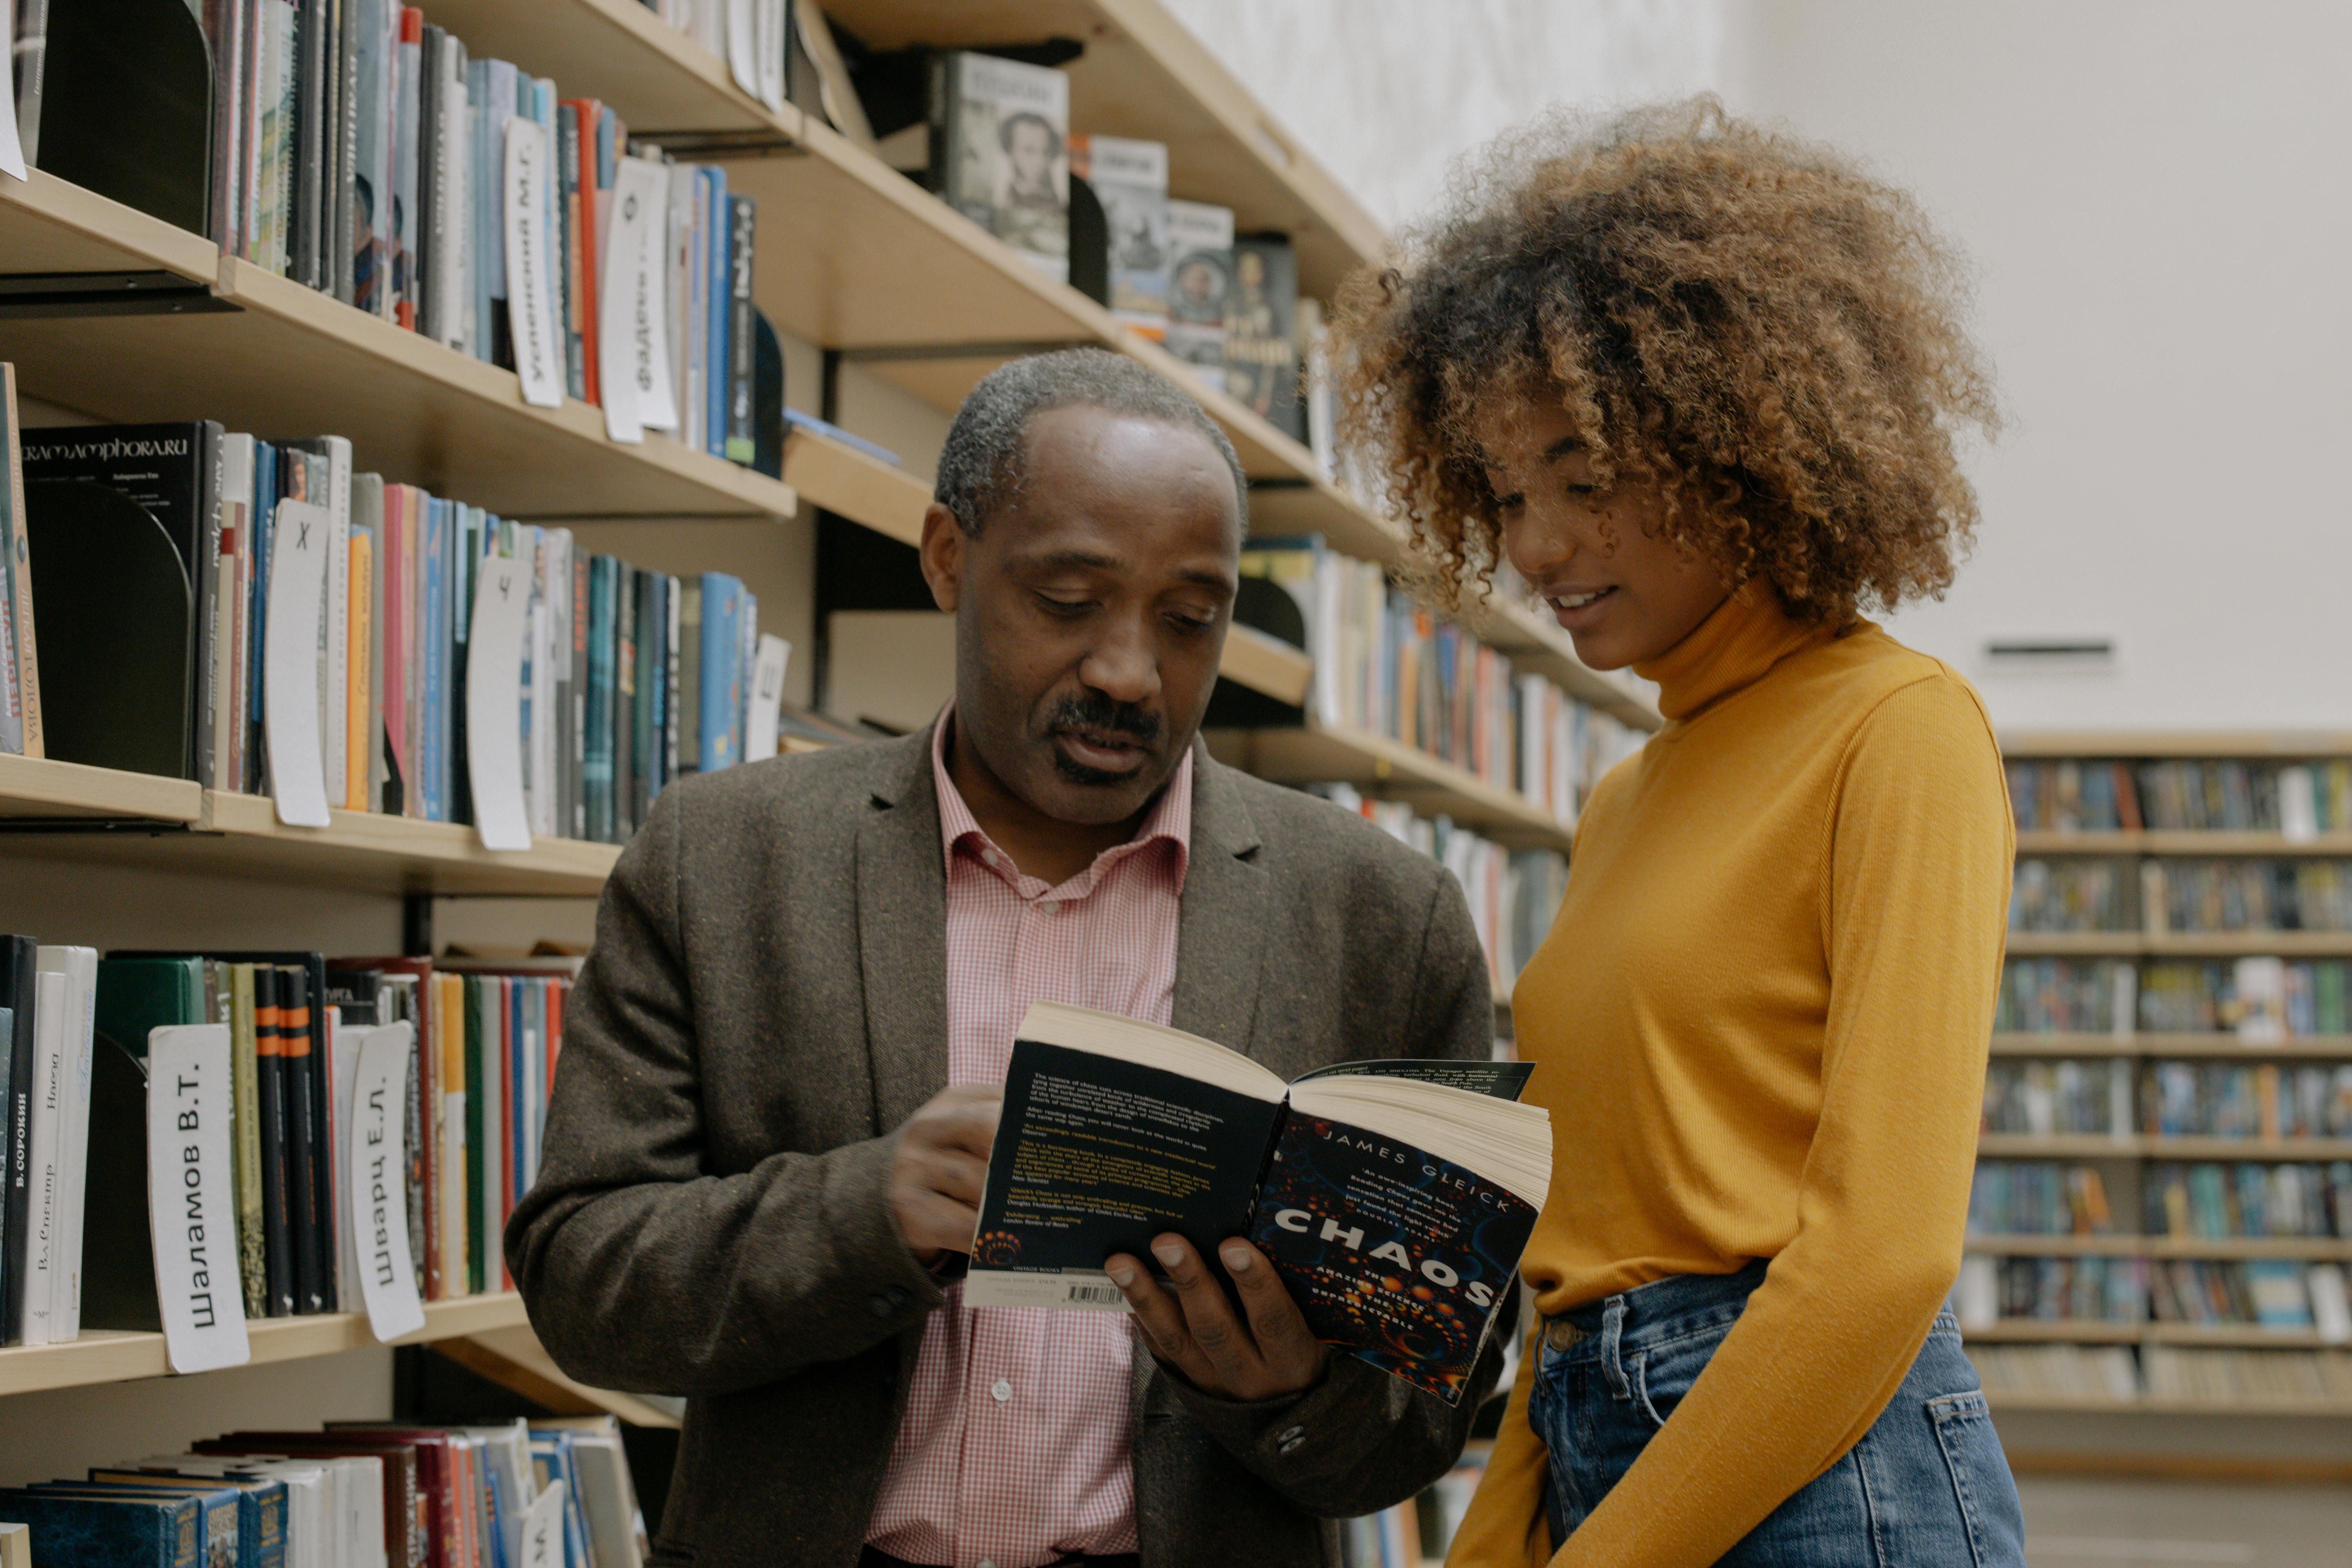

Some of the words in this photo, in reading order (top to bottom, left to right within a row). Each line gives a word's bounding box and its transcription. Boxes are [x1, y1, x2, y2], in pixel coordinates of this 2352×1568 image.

[178, 1063, 199, 1130] В.Т.
[368, 1076, 387, 1146] Е.Л.
[1048, 1076, 1070, 1085] science
[1080, 1082, 1097, 1090] chaos
[1134, 1094, 1165, 1106] traditional
[16, 1092, 27, 1172] СОРОКИН
[1045, 1110, 1067, 1119] reading
[1131, 1126, 1145, 1134] look
[1165, 1135, 1183, 1144] world
[1191, 1143, 1207, 1152] quite
[1323, 1130, 1406, 1164] JAMES
[1422, 1165, 1510, 1213] GLEICK
[1378, 1174, 1433, 1200] awe-inspiring
[372, 1155, 394, 1286] Шварц
[1345, 1193, 1361, 1203] just
[1363, 1199, 1387, 1212] found
[1389, 1209, 1402, 1218] the
[1404, 1214, 1422, 1226] light
[1346, 1185, 1385, 1201] sensation
[1388, 1198, 1404, 1209] that
[1406, 1207, 1440, 1224] someone
[1443, 1222, 1459, 1233] had
[1351, 1175, 1383, 1191] Reading
[1386, 1187, 1410, 1201] Chaos
[1412, 1199, 1432, 1210] gave
[1434, 1208, 1446, 1216] me
[1448, 1214, 1461, 1224] the
[184, 1145, 216, 1329] Шаламов
[1356, 1208, 1399, 1228] DOUGLAS
[1404, 1227, 1436, 1242] ADAMS
[1274, 1208, 1494, 1307] CHAOS
[1365, 1269, 1386, 1282] THE
[1312, 1287, 1414, 1331] UNPREDICTABLE
[1316, 1266, 1372, 1288] AMAZING
[1377, 1286, 1425, 1312] SCIENCE
[1345, 1287, 1361, 1296] OF
[1366, 1294, 1389, 1308] THE
